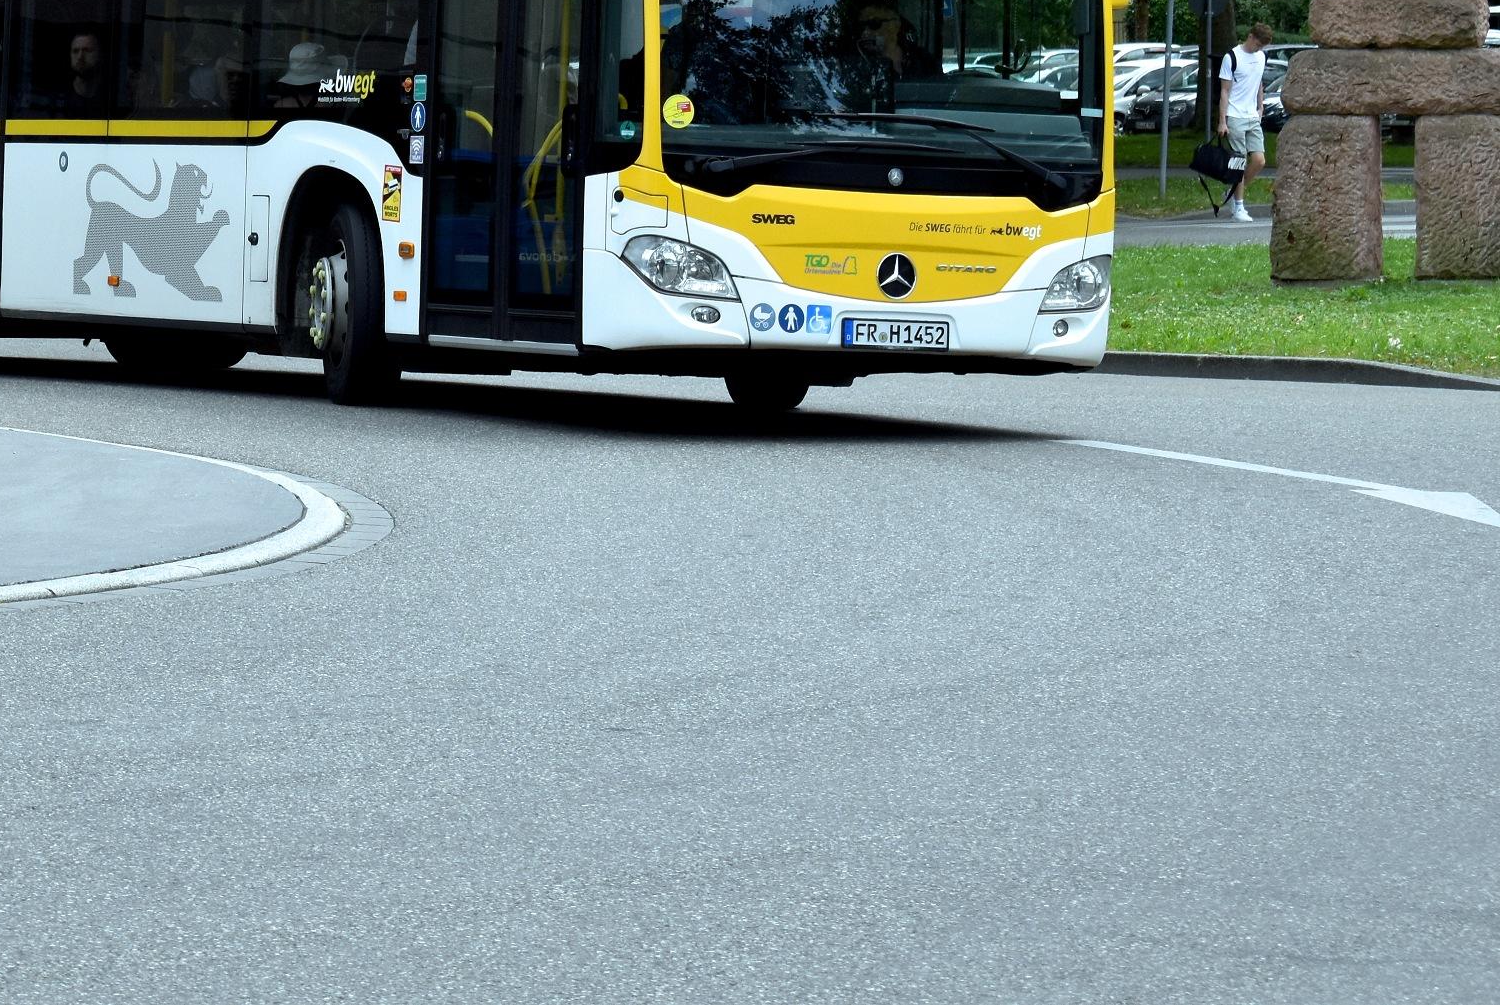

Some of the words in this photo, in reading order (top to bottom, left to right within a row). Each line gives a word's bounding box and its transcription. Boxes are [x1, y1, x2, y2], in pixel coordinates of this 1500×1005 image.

[335, 68, 376, 99] bwegt
[751, 212, 795, 225] SWEG
[909, 221, 923, 232] Die
[925, 222, 951, 233] SWEG
[952, 223, 973, 234] fährt
[974, 224, 987, 235] für
[1005, 223, 1042, 240] bwegt
[804, 254, 830, 267] TGO
[936, 264, 997, 273] CITARO
[855, 323, 877, 343] FR
